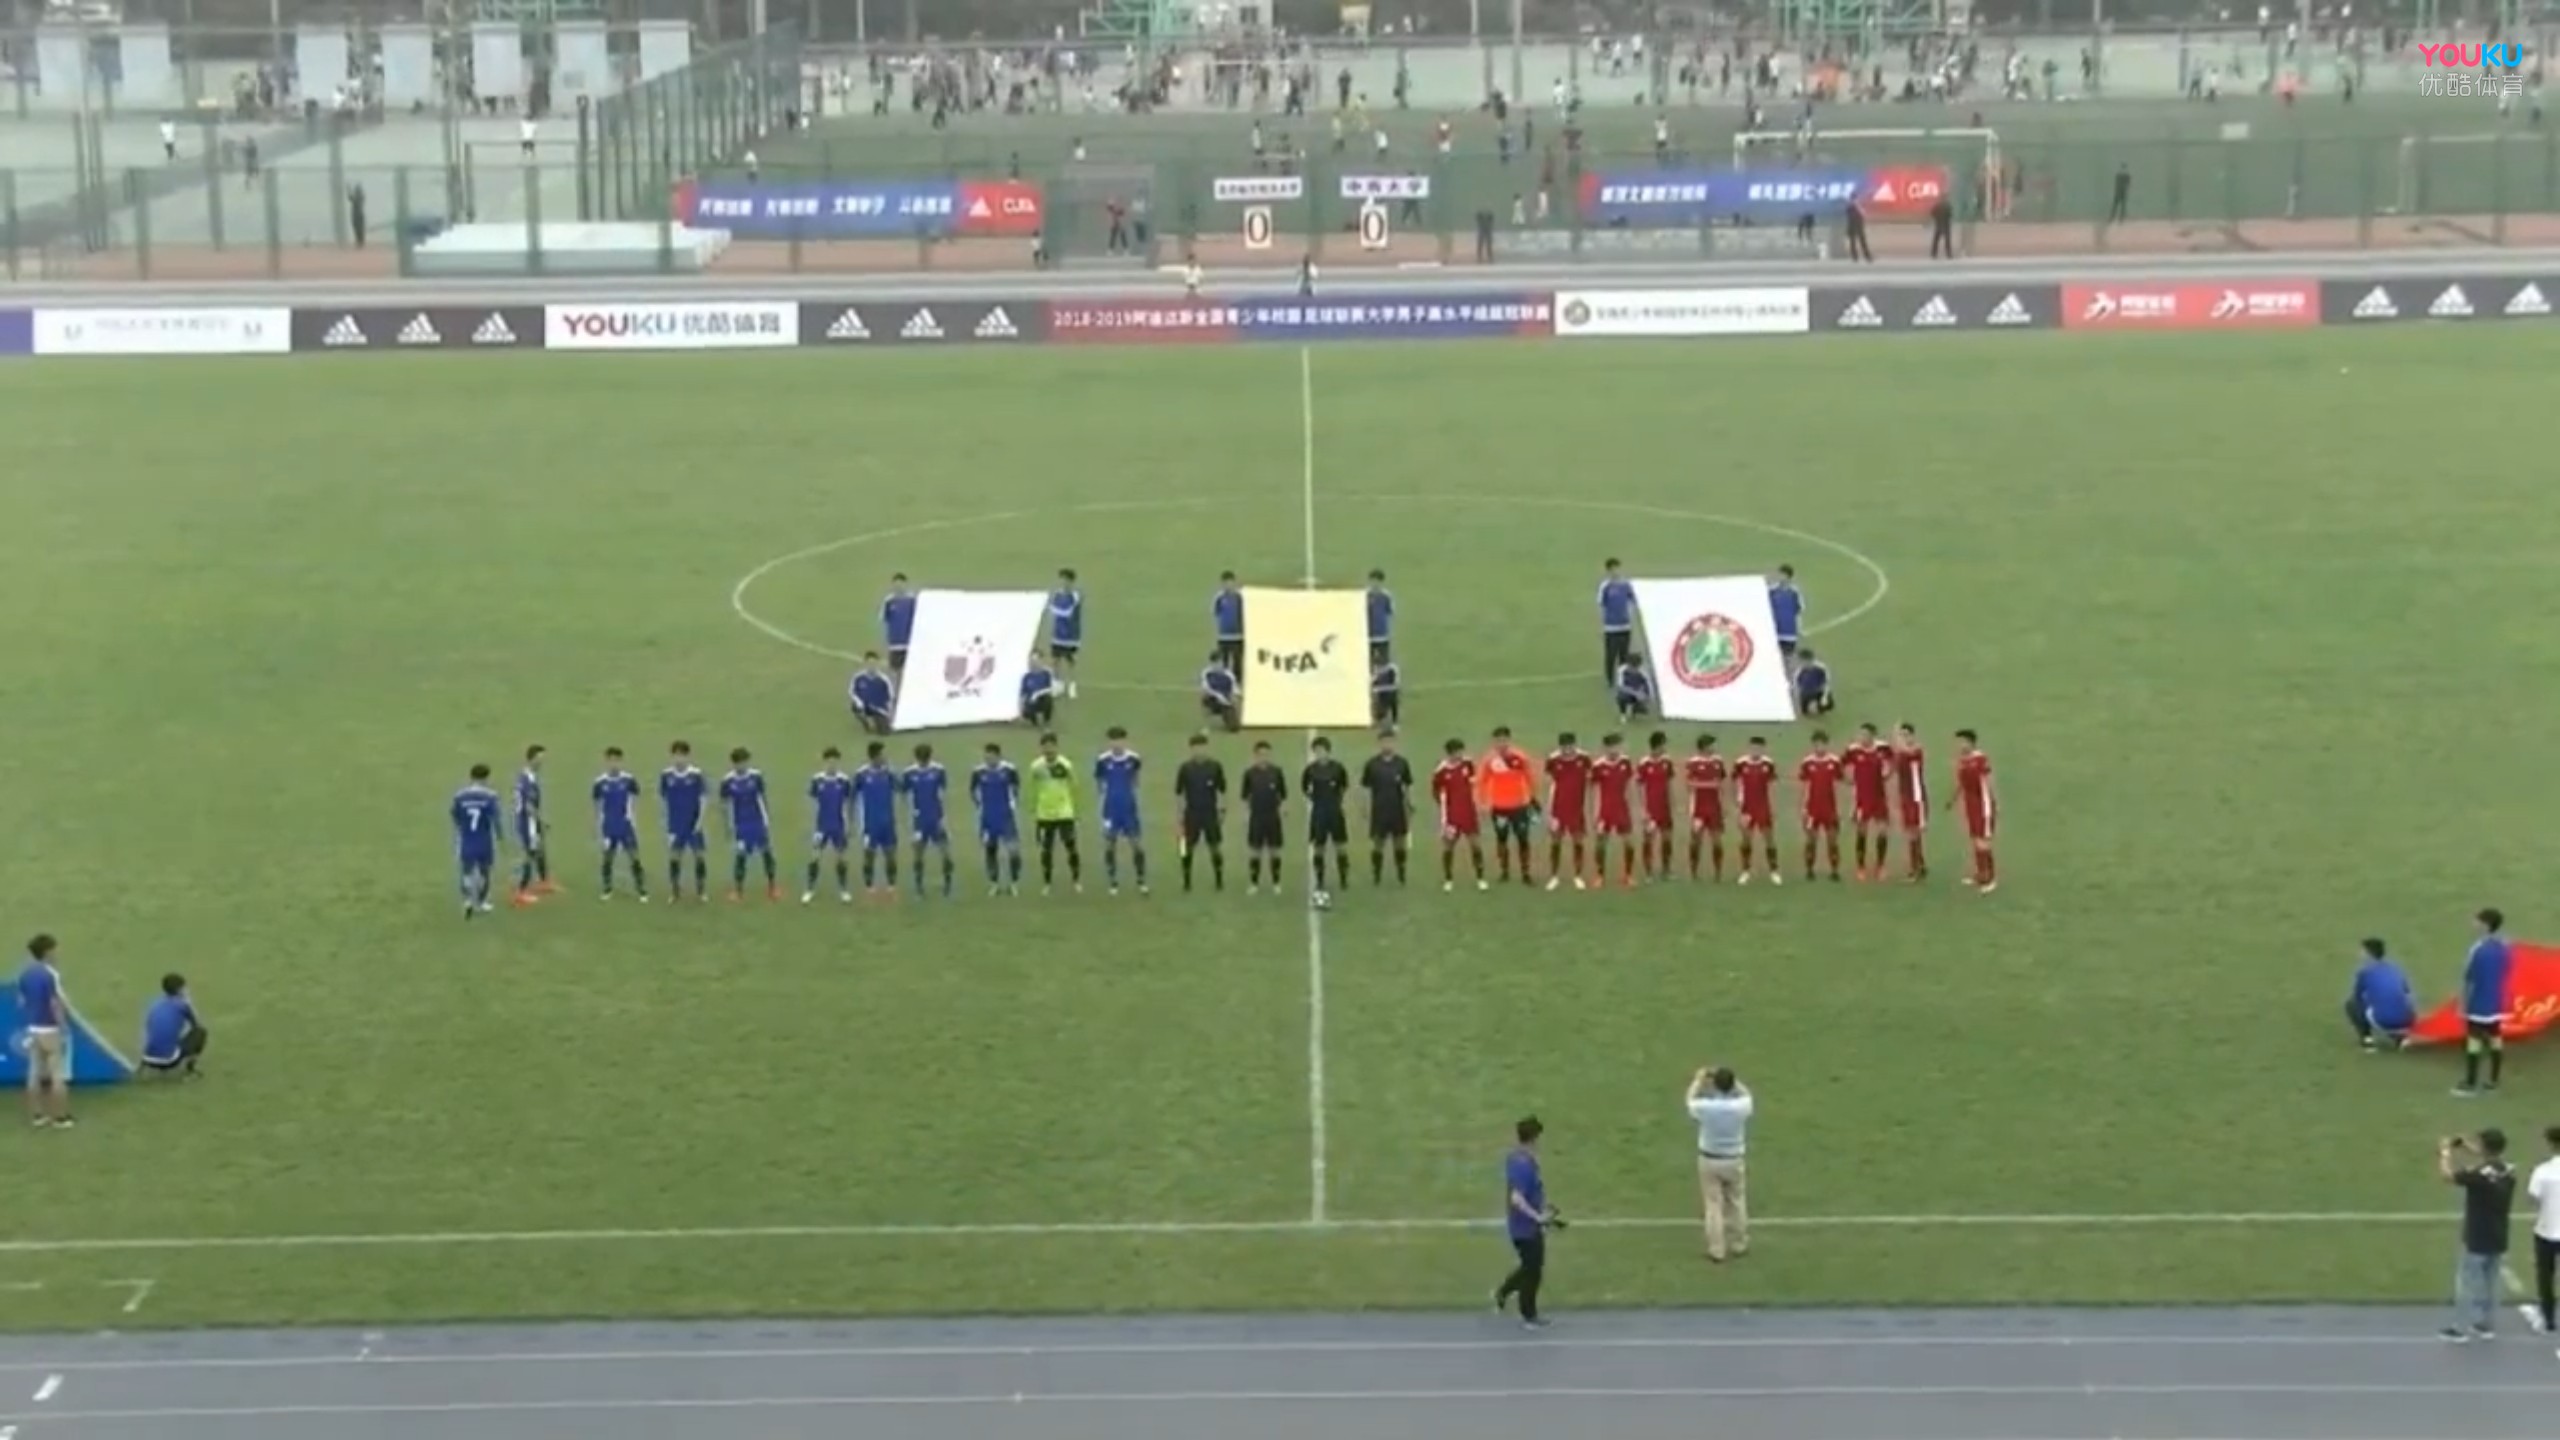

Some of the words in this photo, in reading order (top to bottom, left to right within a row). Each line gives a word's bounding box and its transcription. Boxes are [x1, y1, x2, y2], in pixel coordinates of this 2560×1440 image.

[1247, 210, 1269, 243] 0
[1363, 210, 1385, 242] 0
[563, 313, 676, 336] YOUKU
[683, 312, 780, 335] 优酷体育
[1258, 648, 1318, 673] FIFA
[467, 808, 481, 832] 7
